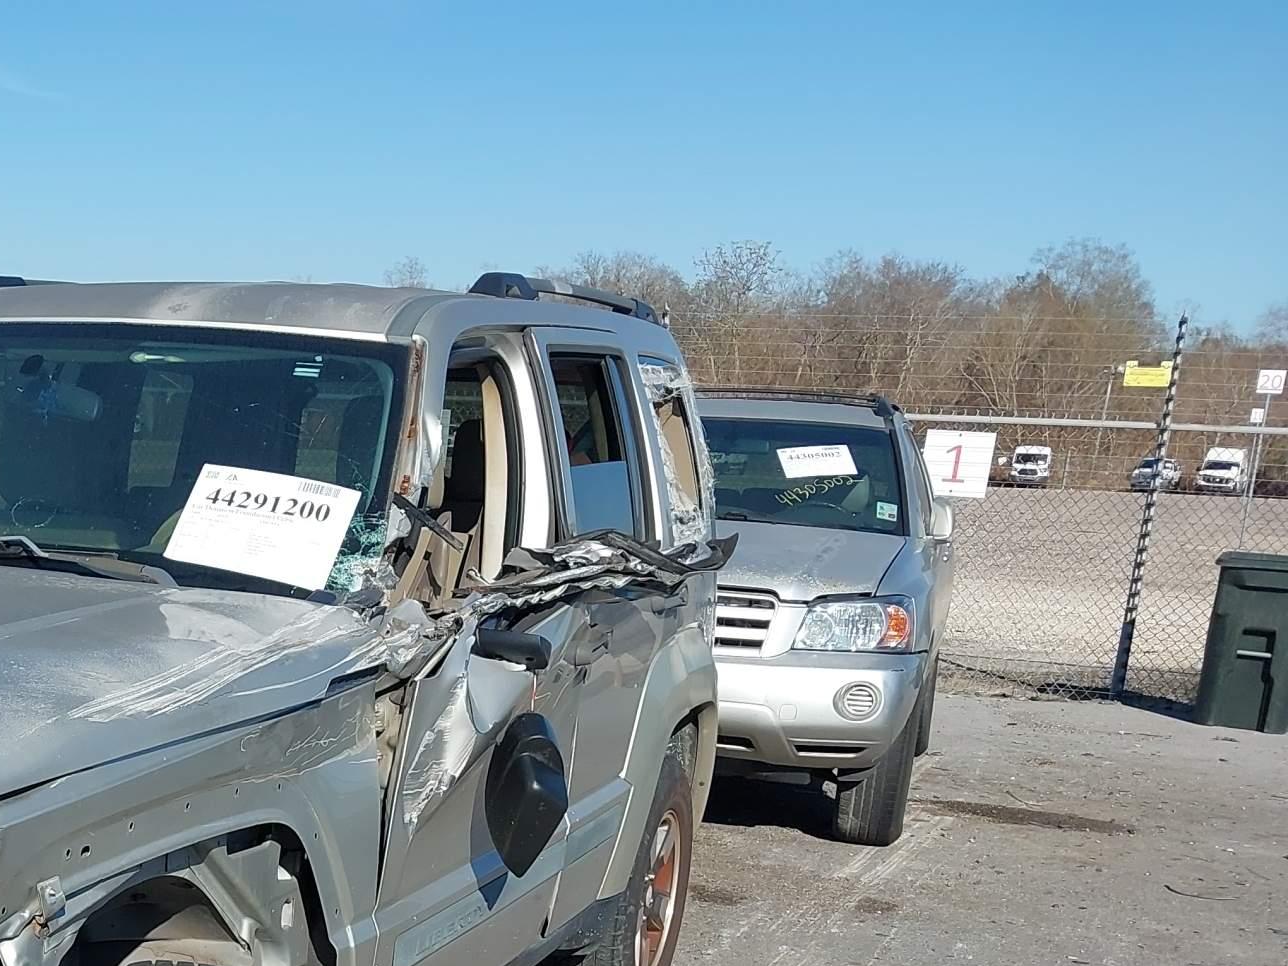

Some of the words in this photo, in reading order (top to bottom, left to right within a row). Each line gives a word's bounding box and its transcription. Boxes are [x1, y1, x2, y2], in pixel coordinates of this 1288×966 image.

[1261, 373, 1283, 389] 20
[941, 444, 965, 483] 1
[205, 487, 331, 522] 44291200
[775, 475, 864, 506] 44305002
